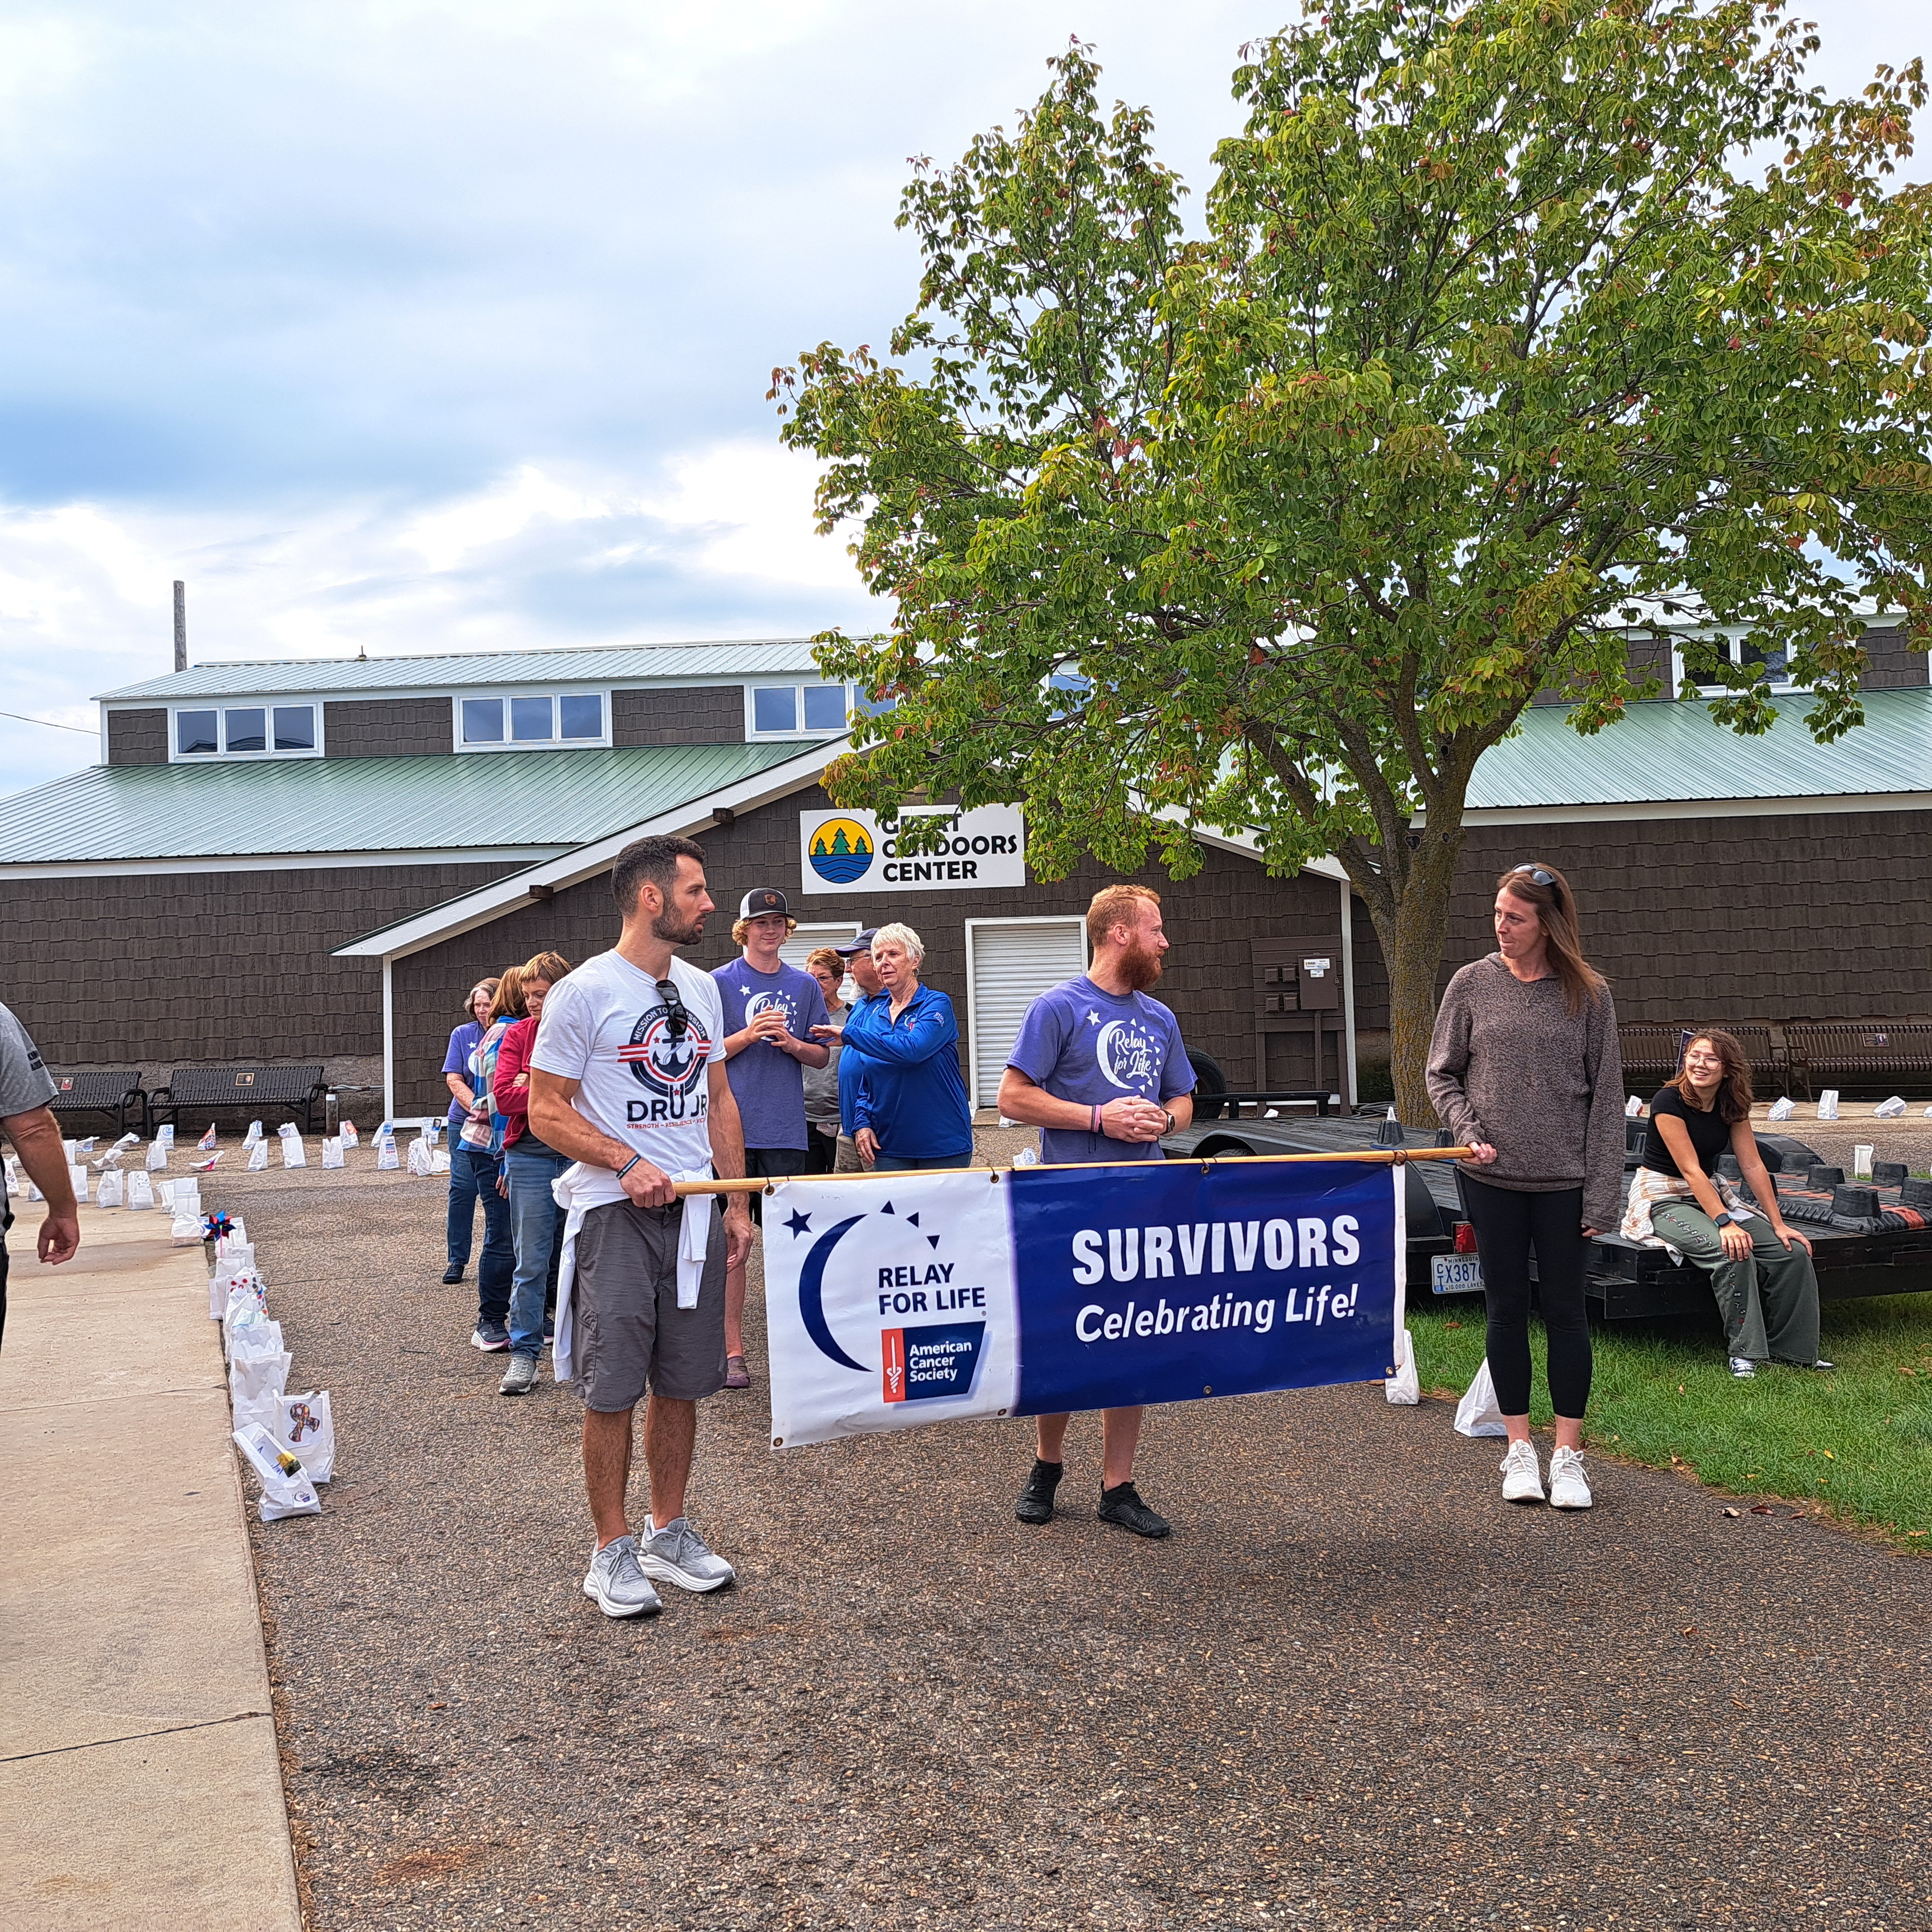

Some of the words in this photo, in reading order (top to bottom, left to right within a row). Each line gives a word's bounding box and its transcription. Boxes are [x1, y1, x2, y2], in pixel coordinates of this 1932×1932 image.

[883, 861, 977, 882] CENTER
[633, 1010, 659, 1041] MISSION
[656, 1007, 668, 1016] TO
[1109, 1028, 1153, 1055] Relay
[1114, 1054, 1128, 1074] for
[1126, 1050, 1152, 1079] Life
[627, 1083, 685, 1122] DRU
[690, 1094, 707, 1117] JR
[1072, 1215, 1360, 1285] SURVIVORS
[879, 1263, 954, 1288] RELAY
[879, 1292, 927, 1315] FOR
[936, 1287, 986, 1310] LIFE
[1076, 1292, 1275, 1342] Celebrating
[1285, 1284, 1358, 1327] Life!
[910, 1341, 972, 1356] American
[910, 1355, 955, 1369] Cancer
[910, 1367, 958, 1383] Society
